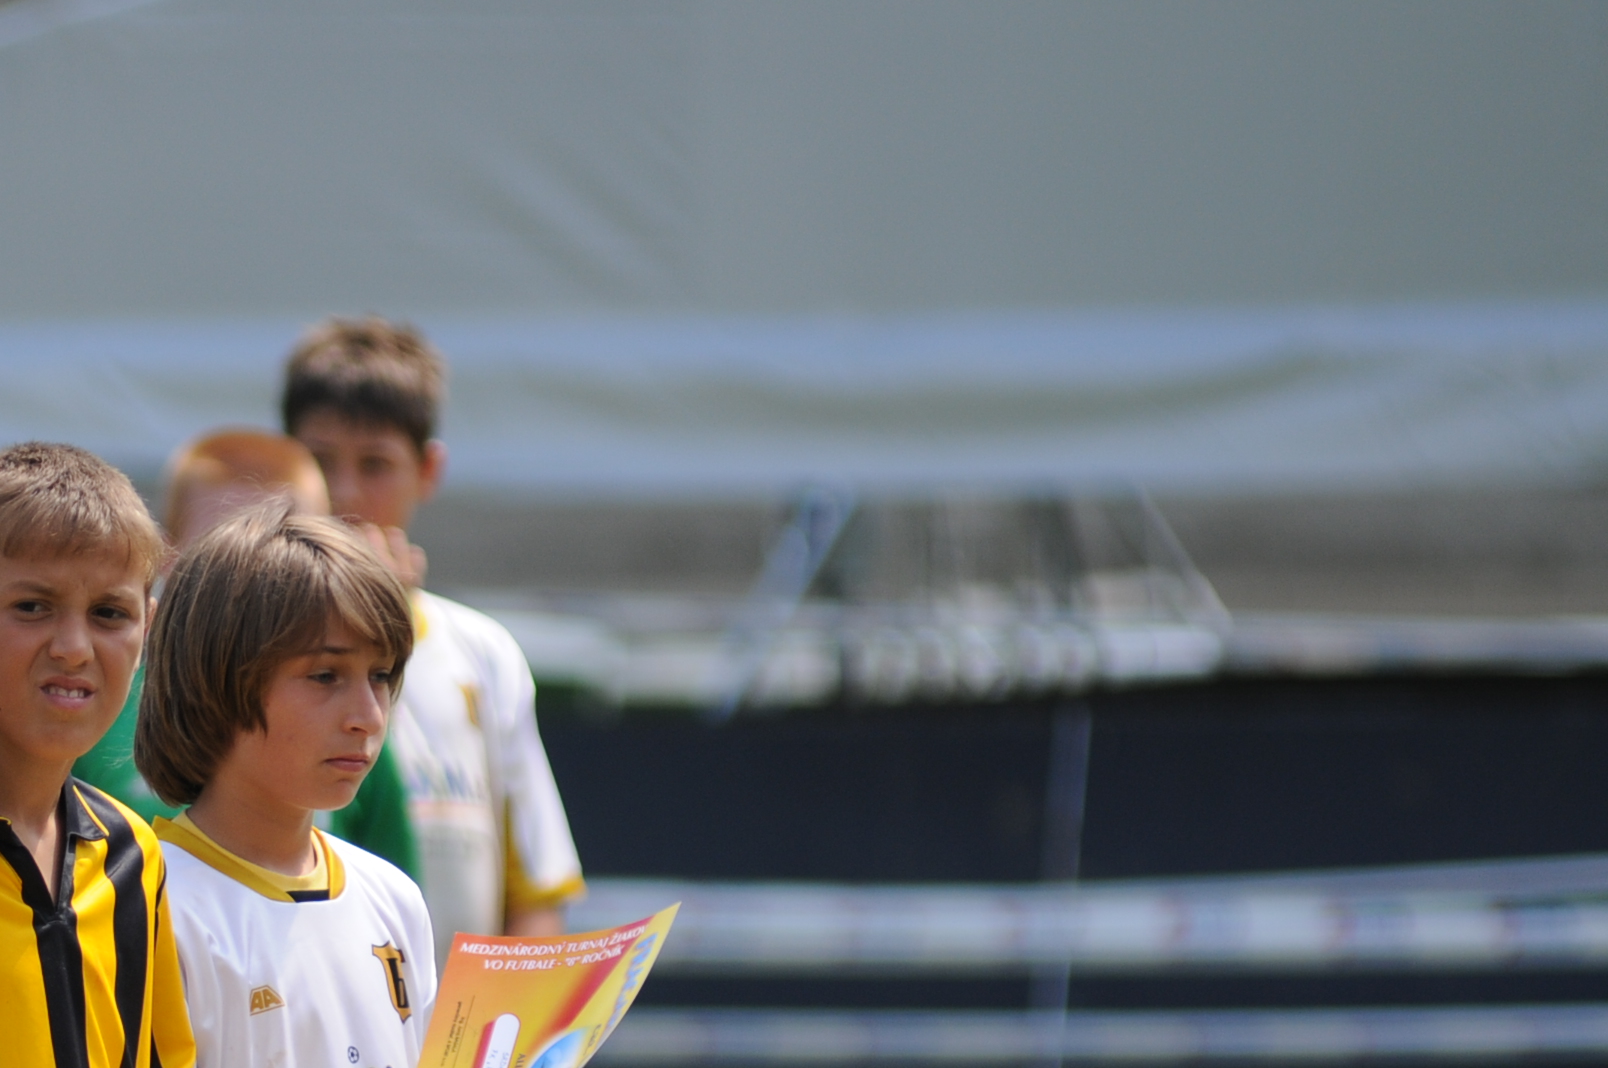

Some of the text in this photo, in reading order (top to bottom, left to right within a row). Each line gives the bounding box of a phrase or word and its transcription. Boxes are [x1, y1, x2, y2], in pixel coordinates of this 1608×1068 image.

[460, 940, 567, 956] MEDZINÁRODNÝ
[566, 936, 608, 954] TURNAJ
[483, 959, 504, 971] VO
[504, 958, 558, 971] FUTBALE
[581, 944, 626, 965] ROČNÍK
[514, 1052, 526, 1068] ALL
